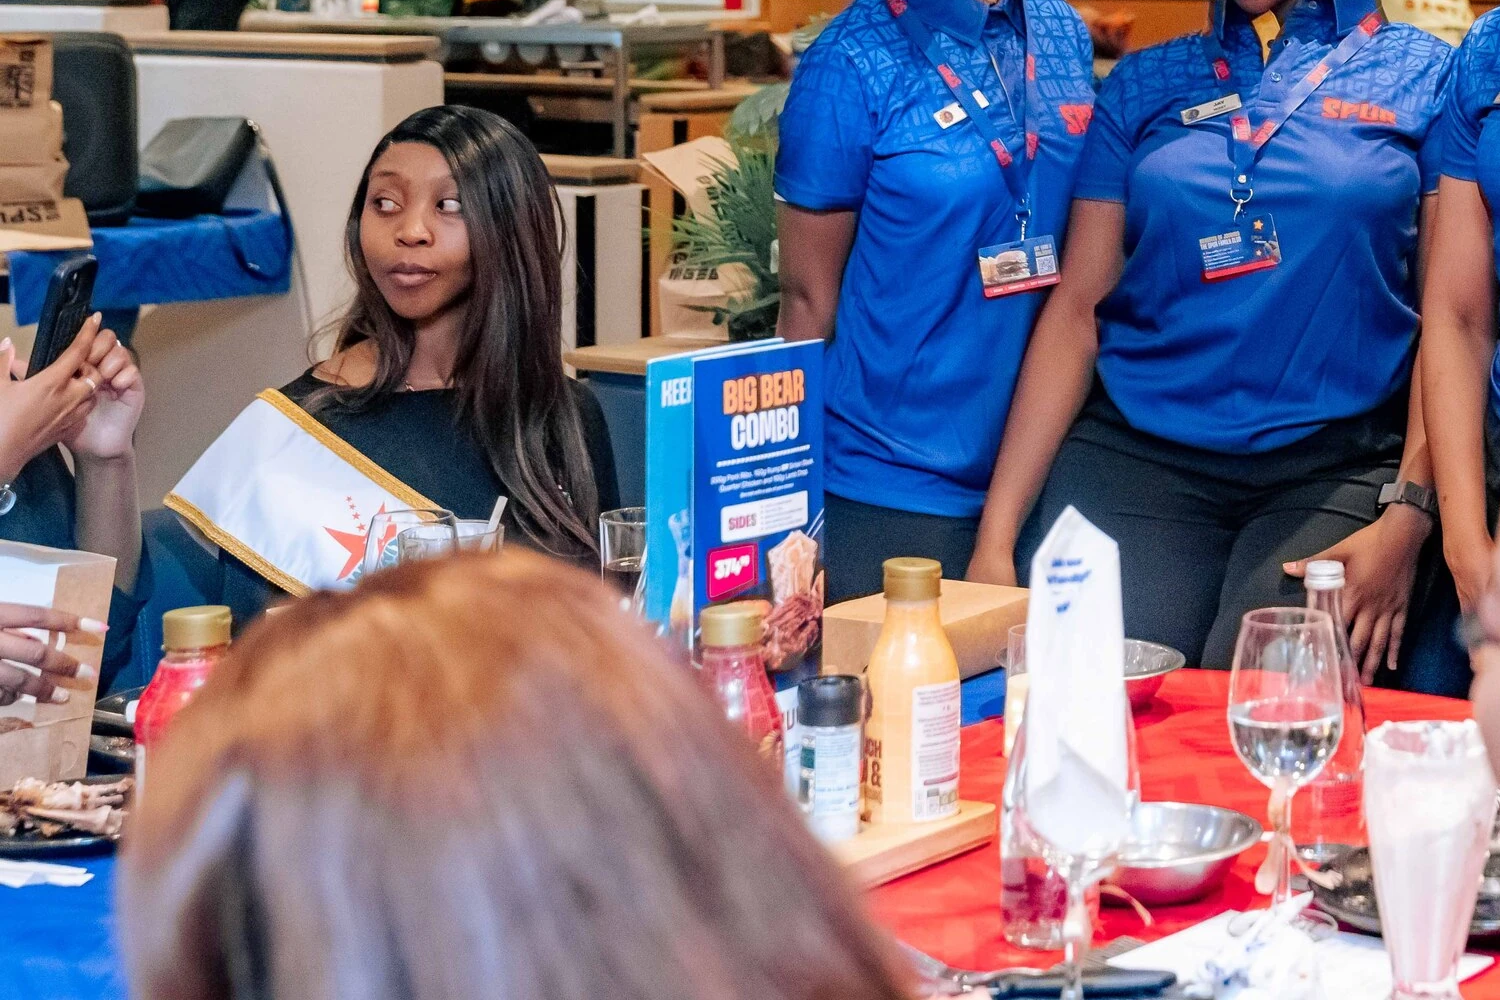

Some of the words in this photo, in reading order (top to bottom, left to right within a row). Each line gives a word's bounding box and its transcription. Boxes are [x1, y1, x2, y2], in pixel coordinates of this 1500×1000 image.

[1321, 96, 1397, 126] SPUR
[722, 375, 758, 415] BIG
[760, 368, 805, 409] BEAR
[731, 405, 800, 451] COMBO
[728, 513, 757, 531] SIDES
